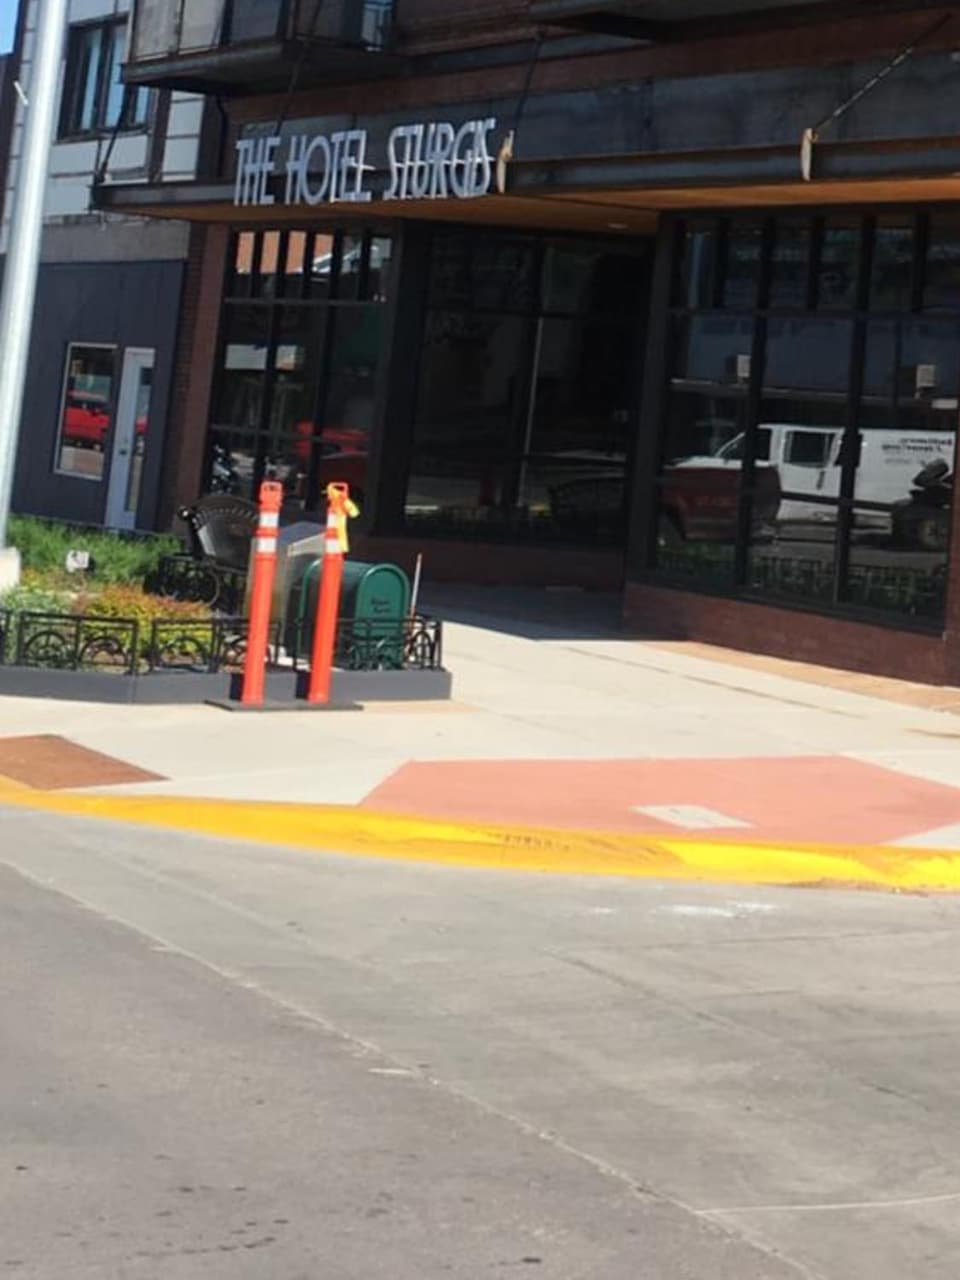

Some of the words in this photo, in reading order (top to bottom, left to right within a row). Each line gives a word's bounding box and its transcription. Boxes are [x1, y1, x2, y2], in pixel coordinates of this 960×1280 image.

[234, 136, 281, 206] THE
[285, 129, 373, 205] HOTEL
[382, 117, 496, 200] STURGIS
